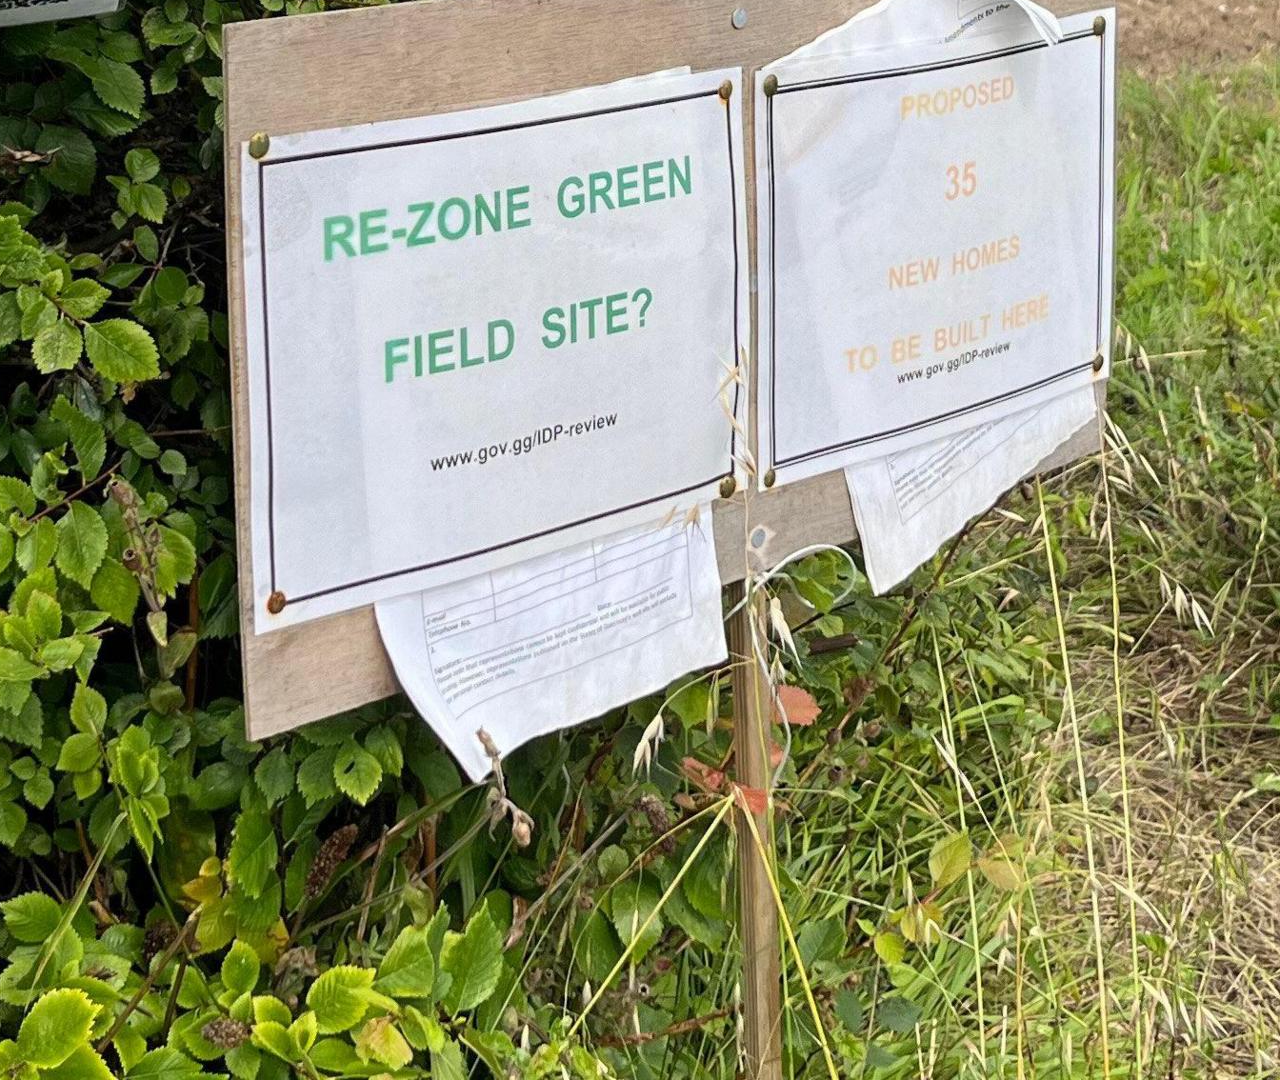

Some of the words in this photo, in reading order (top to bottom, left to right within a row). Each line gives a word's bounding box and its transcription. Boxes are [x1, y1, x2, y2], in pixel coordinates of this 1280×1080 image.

[900, 75, 1015, 120] PROPOSED
[323, 185, 532, 262] RE-ZONE
[557, 155, 692, 218] GREEN
[944, 160, 977, 201] 35
[887, 256, 941, 290] NEW
[951, 234, 1022, 276] HOMES
[384, 319, 515, 383] FIELD
[541, 287, 653, 350] SITE?
[844, 344, 879, 373] TO
[891, 334, 922, 364] BE
[934, 313, 992, 353] BUILT
[1001, 292, 1050, 331] HERE
[897, 341, 1011, 384] wwwgovgg/IDP-review
[430, 413, 618, 471] www.gov.gg/IDP-review
